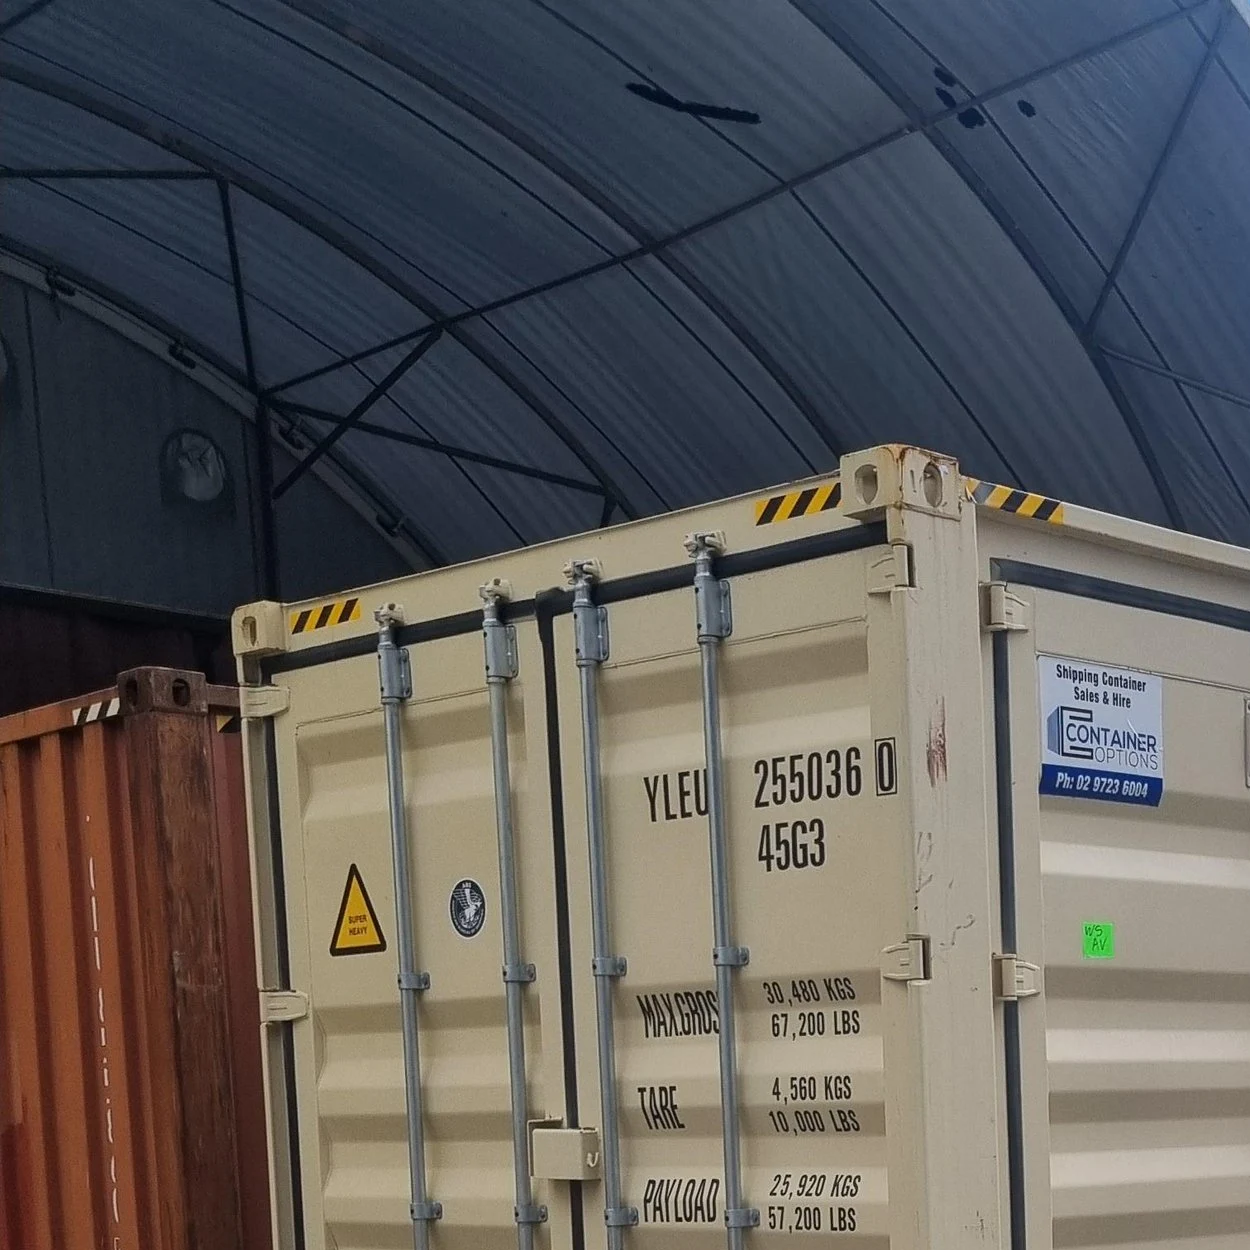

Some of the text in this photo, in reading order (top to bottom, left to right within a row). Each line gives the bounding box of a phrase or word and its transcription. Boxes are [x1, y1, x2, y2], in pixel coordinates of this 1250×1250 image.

[1056, 664, 1147, 692] Shipping Container
[1074, 686, 1131, 708] Sales & Hire
[1066, 723, 1157, 753] CONTAINER
[1095, 747, 1158, 771] OPTIONS
[643, 741, 895, 822] YLEU 255036 0
[1055, 772, 1148, 798] Ph: 02 9723 6004
[758, 818, 826, 872] 45G3
[348, 915, 367, 925] SUPER
[348, 927, 367, 936] HEAVY
[636, 977, 856, 1038] MAX.GROS 30,480 KGS
[771, 1010, 860, 1041] 67,200 LBS
[638, 1075, 852, 1130] TARE 4,560 KGS
[769, 1109, 860, 1136] 10,000 LBS
[643, 1174, 861, 1223] PAYLOAD 25,920 KGS
[768, 1206, 856, 1234] 57,200 LBS
